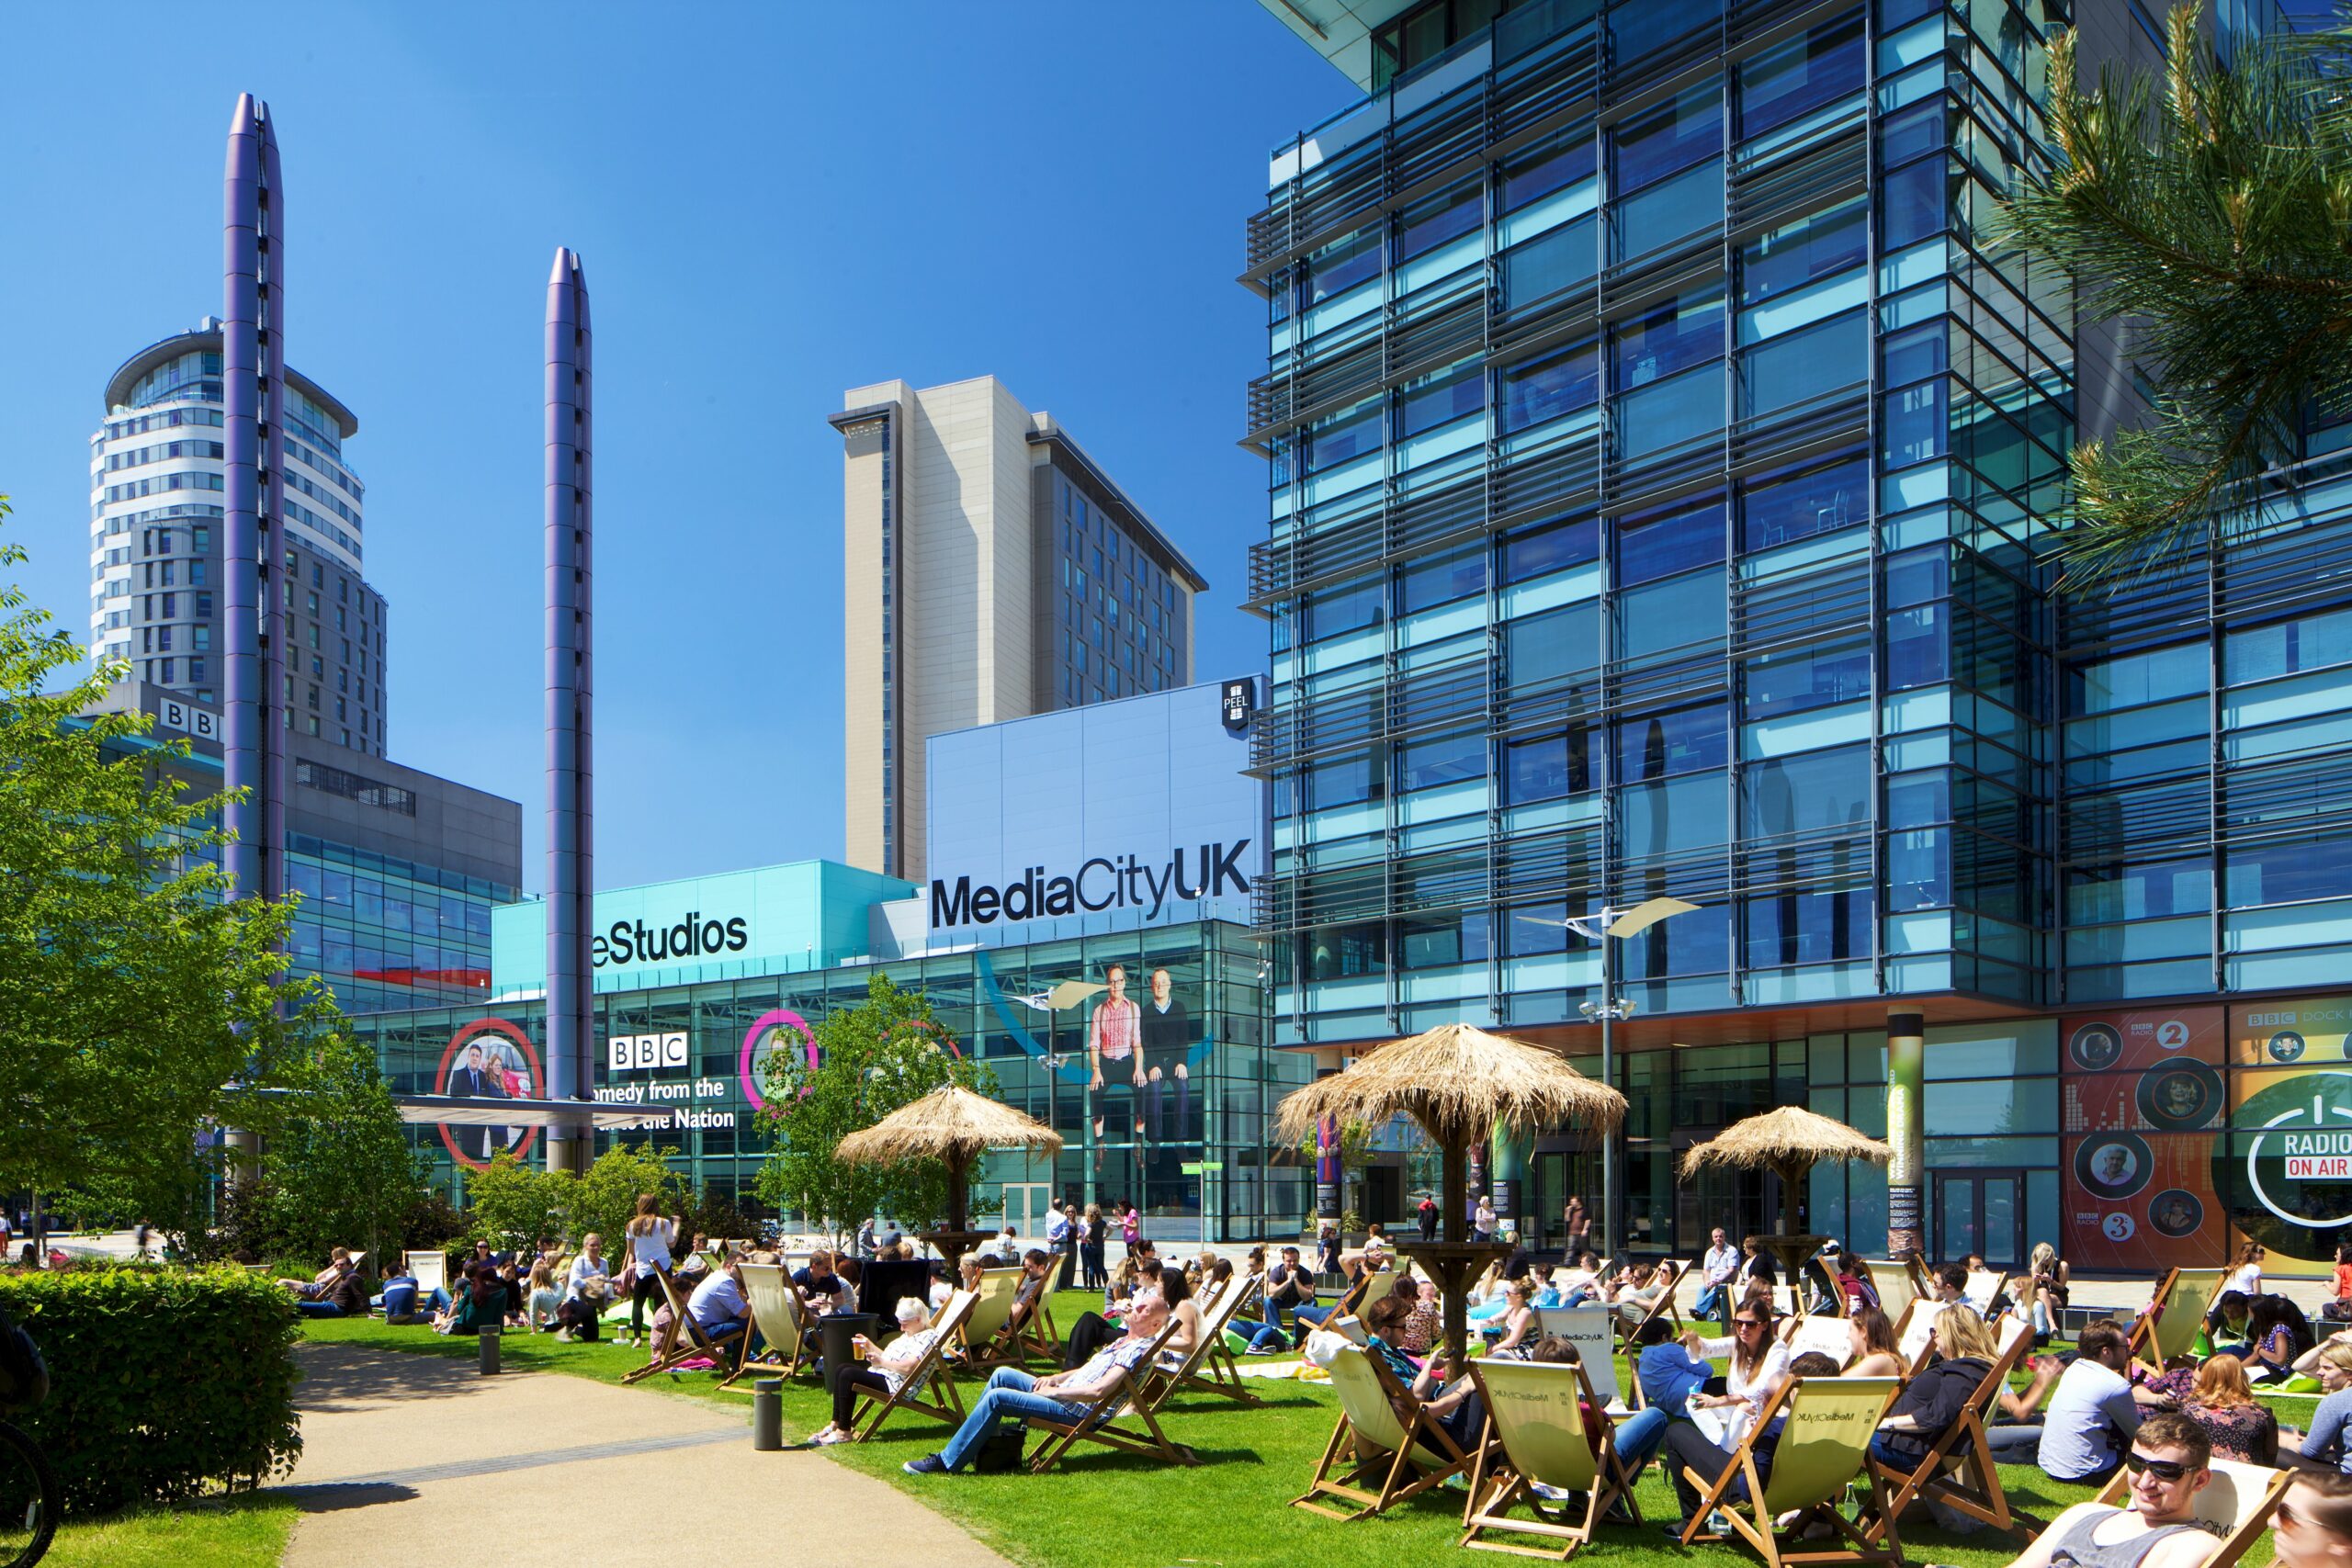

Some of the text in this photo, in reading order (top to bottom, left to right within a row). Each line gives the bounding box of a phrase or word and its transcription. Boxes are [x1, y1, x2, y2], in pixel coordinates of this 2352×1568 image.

[1224, 695, 1248, 709] PEEL
[164, 700, 220, 738] BB
[932, 839, 1251, 928] MediaCityUK
[2250, 1010, 2345, 1026] BBC DOCK
[2165, 1024, 2182, 1044] 2
[612, 1034, 686, 1068] BBC
[649, 1080, 690, 1100] from
[695, 1077, 724, 1098] the
[675, 1108, 734, 1129] Nation
[2285, 1134, 2352, 1155] RADIO
[2289, 1159, 2347, 1176] ON AIR
[1561, 1333, 1604, 1341] MediaCityUK
